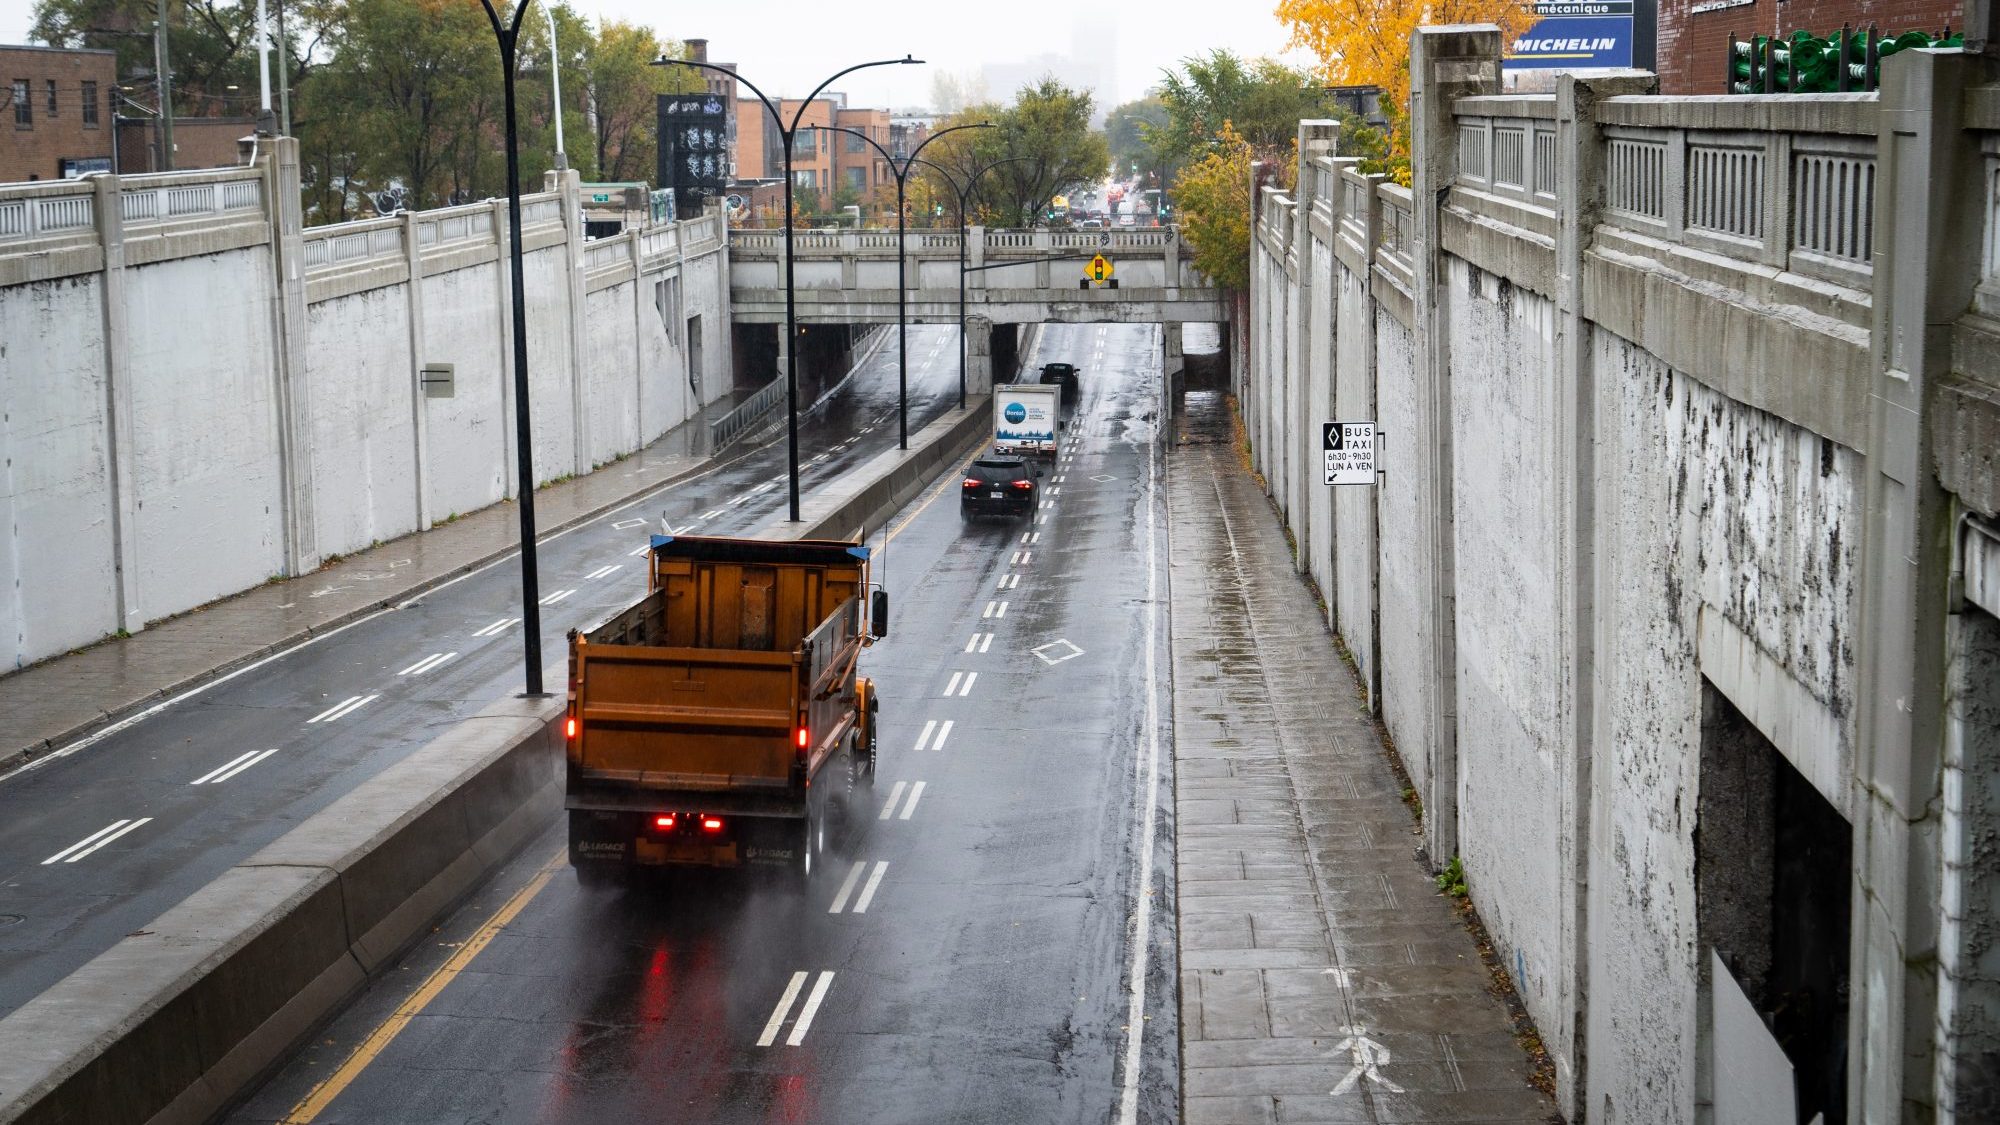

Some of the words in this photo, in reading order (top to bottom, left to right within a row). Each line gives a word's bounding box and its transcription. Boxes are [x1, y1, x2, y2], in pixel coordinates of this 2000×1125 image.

[1537, 4, 1609, 14] mécanique
[1513, 38, 1616, 51] MICHELIN
[1345, 428, 1371, 437] BUS
[1345, 440, 1372, 449] TAXI
[1328, 452, 1347, 461] 6h30
[1353, 452, 1371, 461] 9h30
[1327, 462, 1344, 471] LUN
[1355, 462, 1372, 470] VEN
